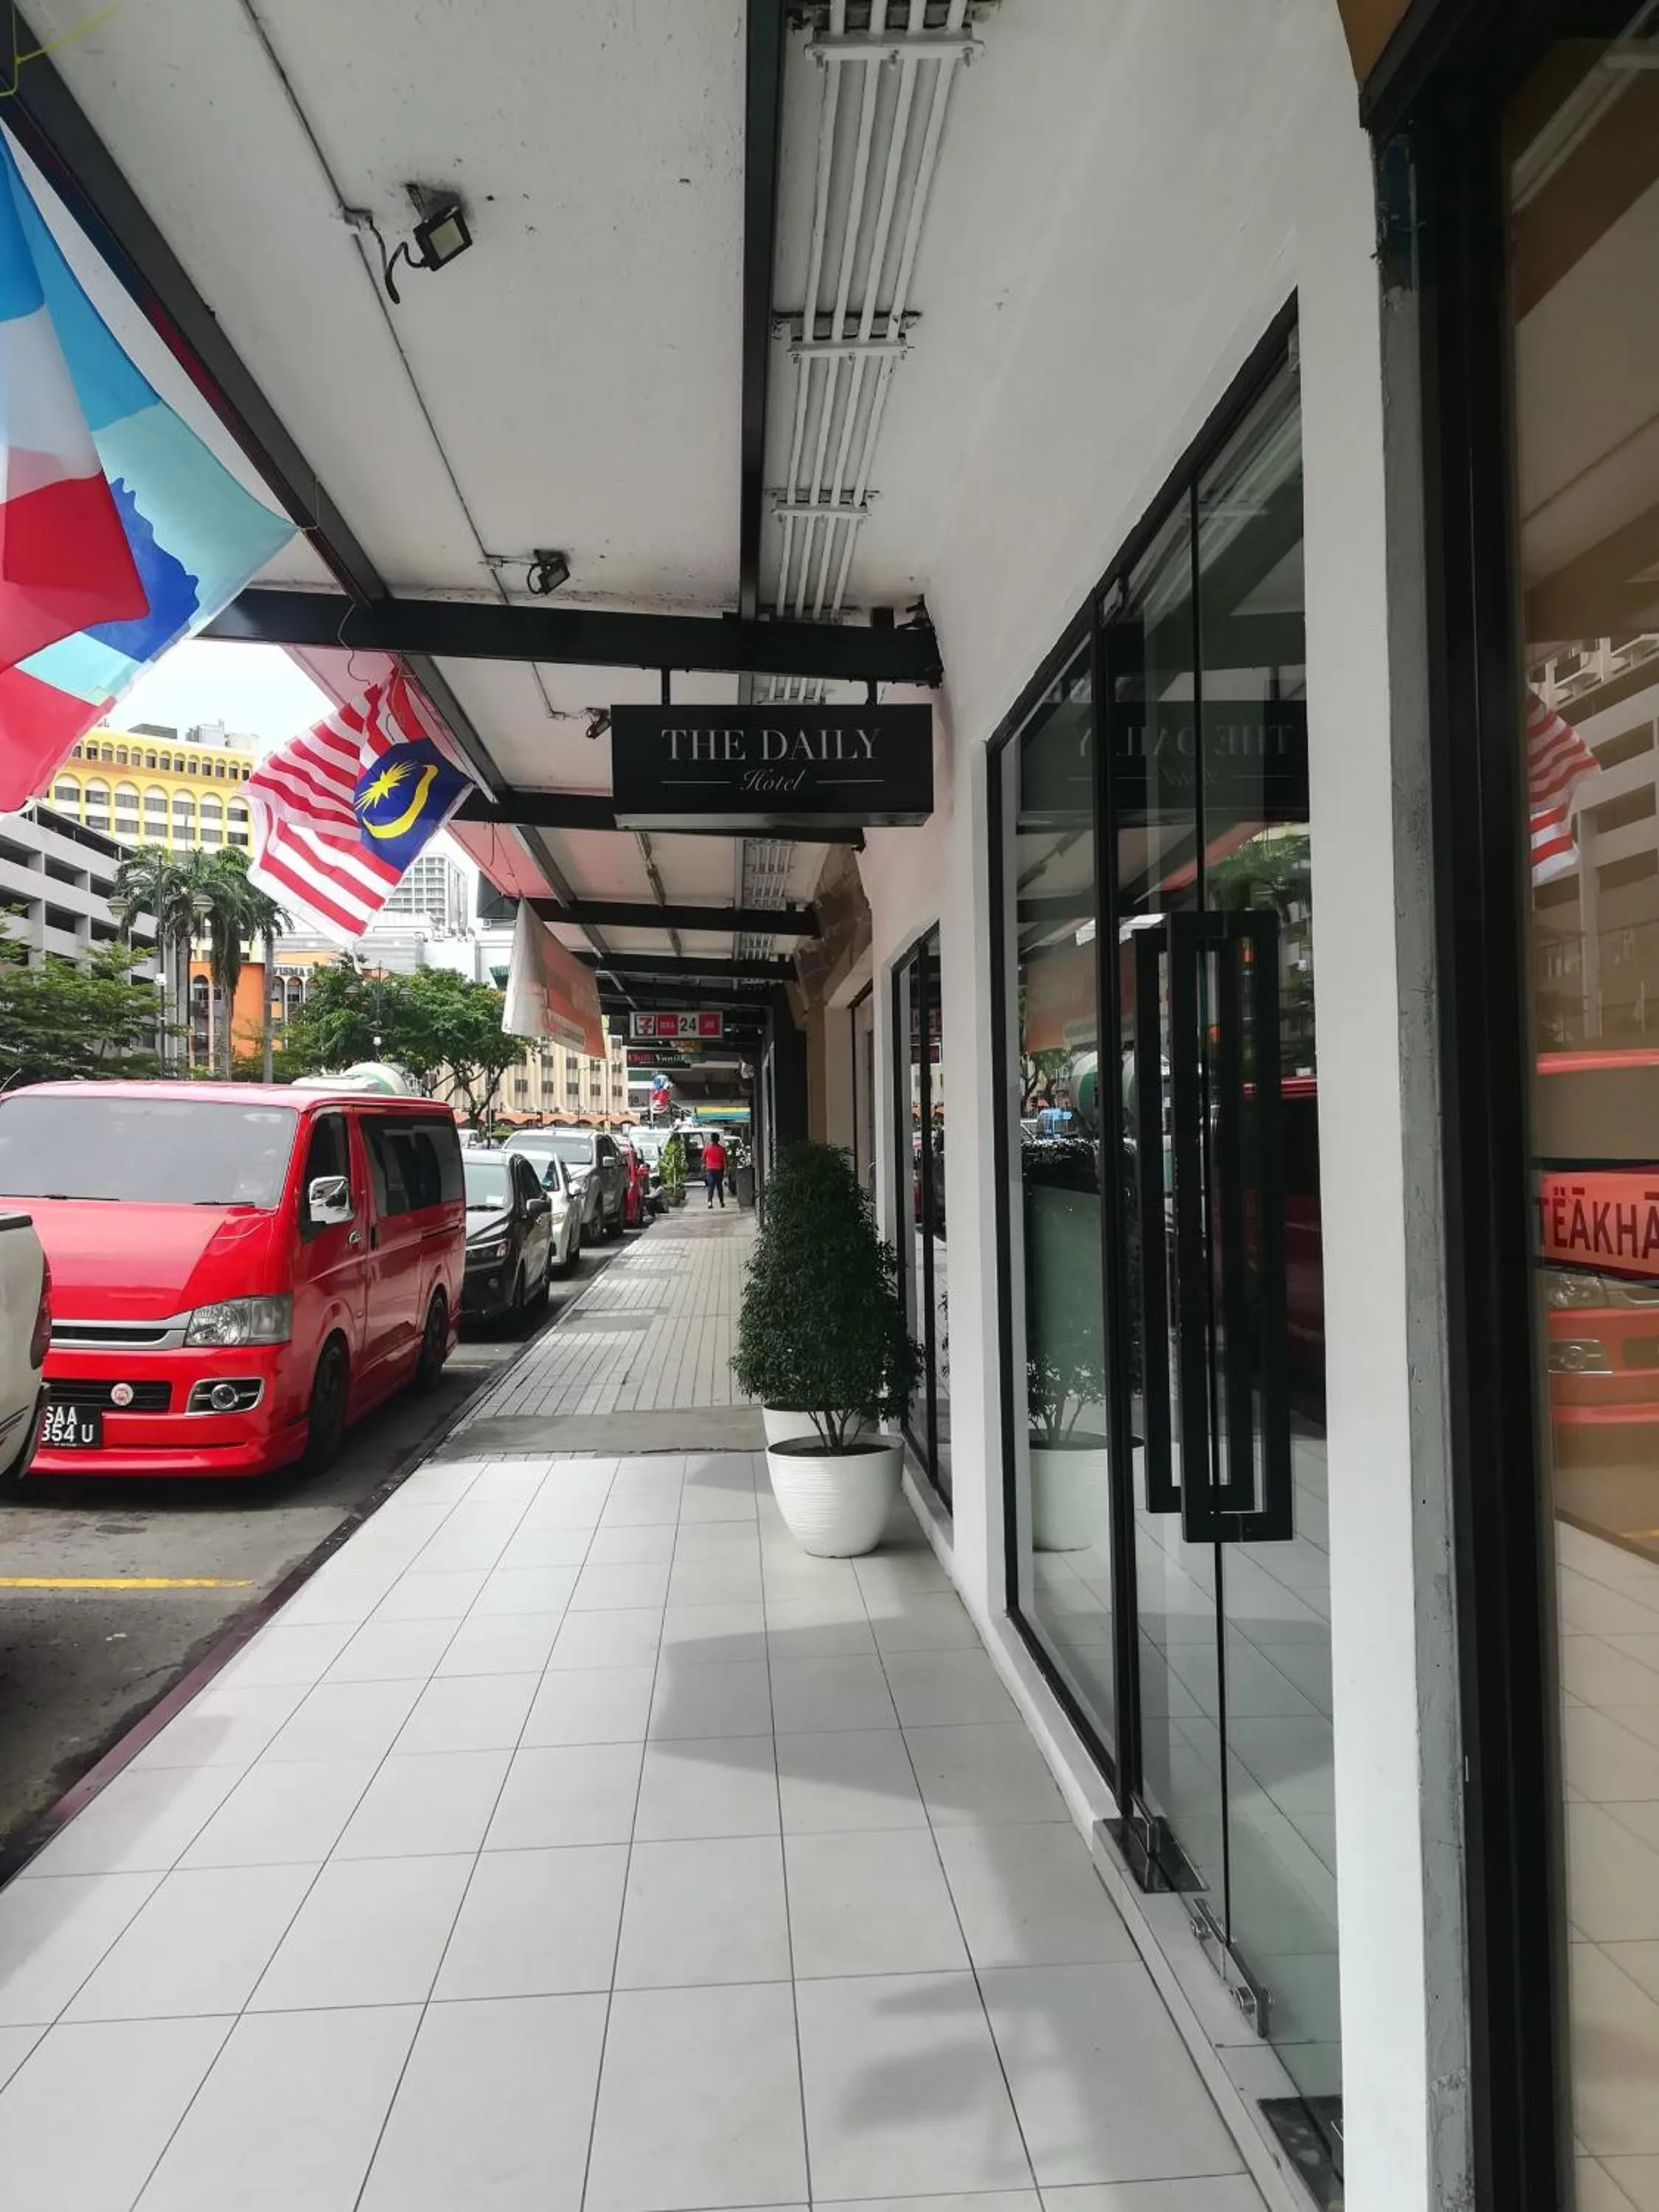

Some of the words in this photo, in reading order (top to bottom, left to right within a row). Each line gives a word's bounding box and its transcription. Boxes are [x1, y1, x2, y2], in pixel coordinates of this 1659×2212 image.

[661, 728, 745, 760] THE
[762, 728, 882, 760] DAILY
[740, 769, 807, 792] Hotel
[680, 1018, 697, 1032] 24
[45, 1406, 77, 1425] SAA
[81, 1424, 94, 1443] U
